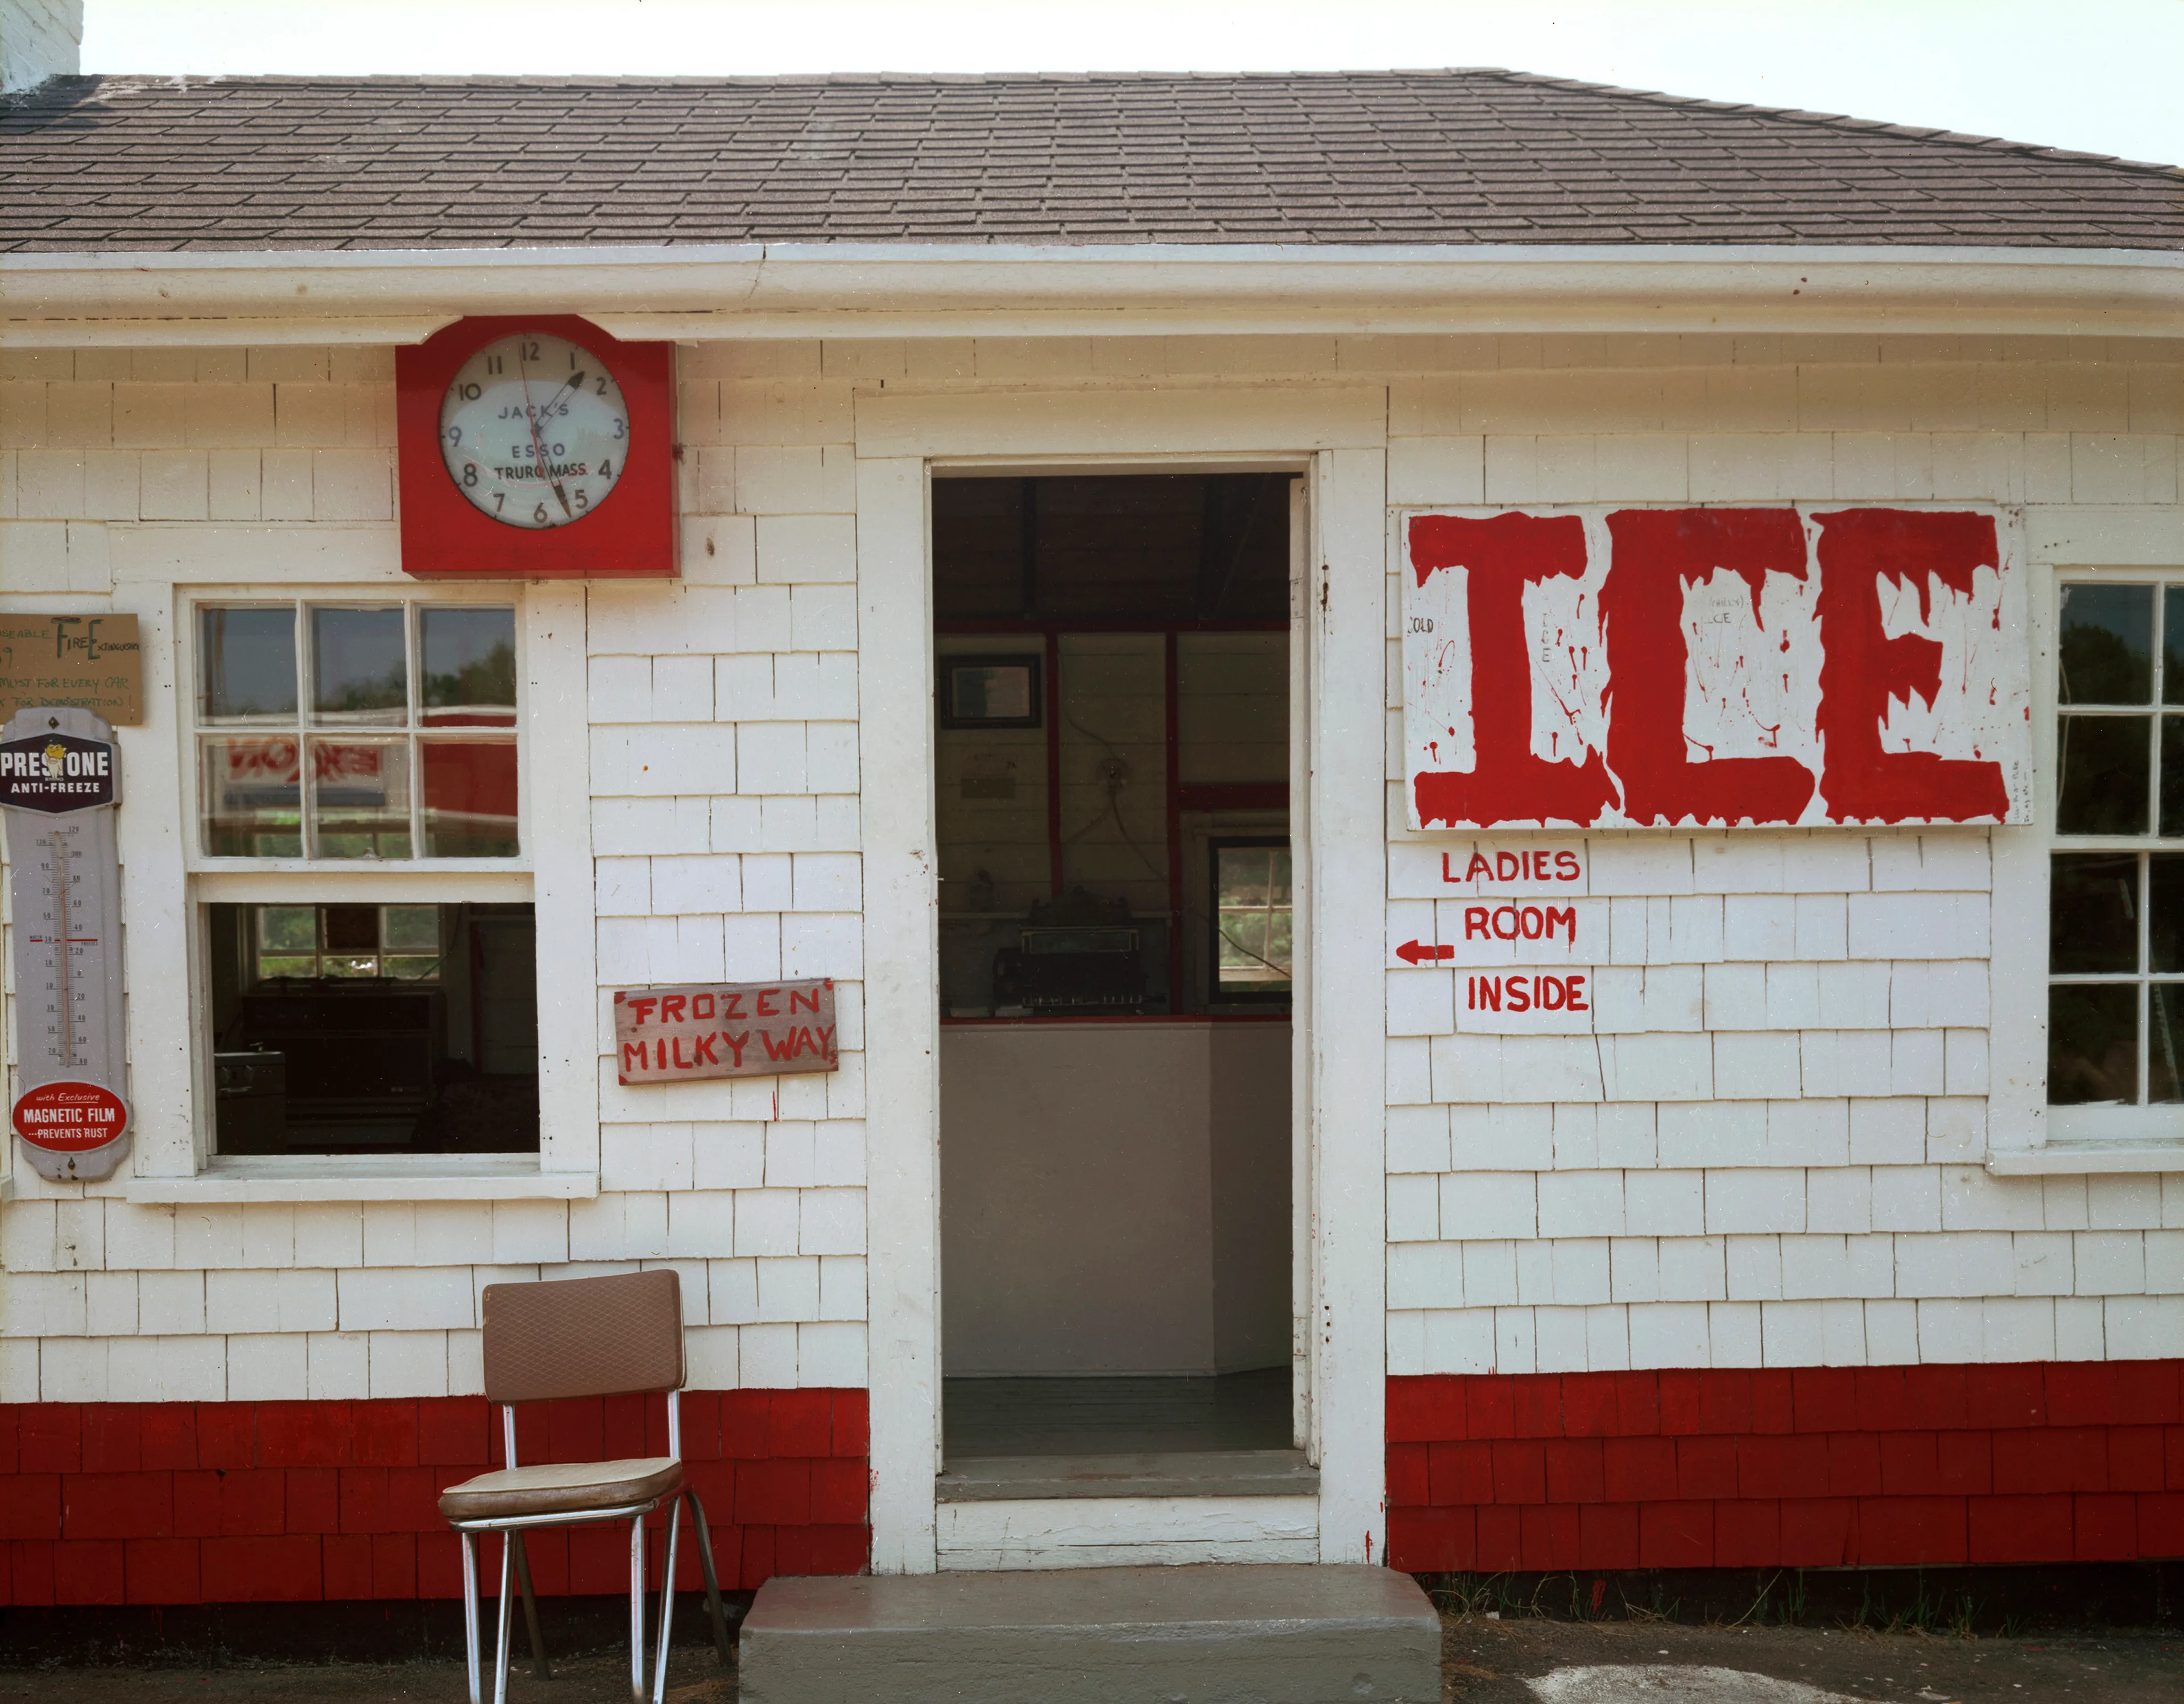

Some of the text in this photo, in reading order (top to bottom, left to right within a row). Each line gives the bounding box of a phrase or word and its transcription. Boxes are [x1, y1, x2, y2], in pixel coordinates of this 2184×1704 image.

[522, 342, 540, 361] 12
[487, 356, 503, 374] 11
[570, 353, 576, 370] 1
[459, 383, 481, 401] 10
[596, 377, 607, 395] 2
[498, 403, 569, 419] JACK'S
[448, 426, 462, 447] 9
[614, 418, 624, 440] 3
[512, 443, 565, 458] ESSO
[464, 464, 478, 487] 8
[598, 460, 611, 479] 4
[493, 493, 506, 512] 7
[574, 490, 588, 509] 5
[533, 503, 548, 523] 6
[51, 617, 88, 659] FIRE
[1409, 508, 2009, 827] ICE
[36, 677, 60, 688] FOR
[63, 677, 100, 694] EVERY
[105, 677, 129, 689] CAR
[11, 783, 100, 793] ANTI-FREEZE
[1442, 851, 1581, 883] LADIES
[1465, 906, 1576, 942] ROOM
[1469, 975, 1589, 1012] INSIDE
[628, 988, 820, 1024] FROZEN
[624, 1030, 750, 1072] MILKY
[58, 1093, 100, 1102] Exclusive
[24, 1108, 115, 1123] MAGNETIC FILM
[84, 1128, 108, 1138] RUST
